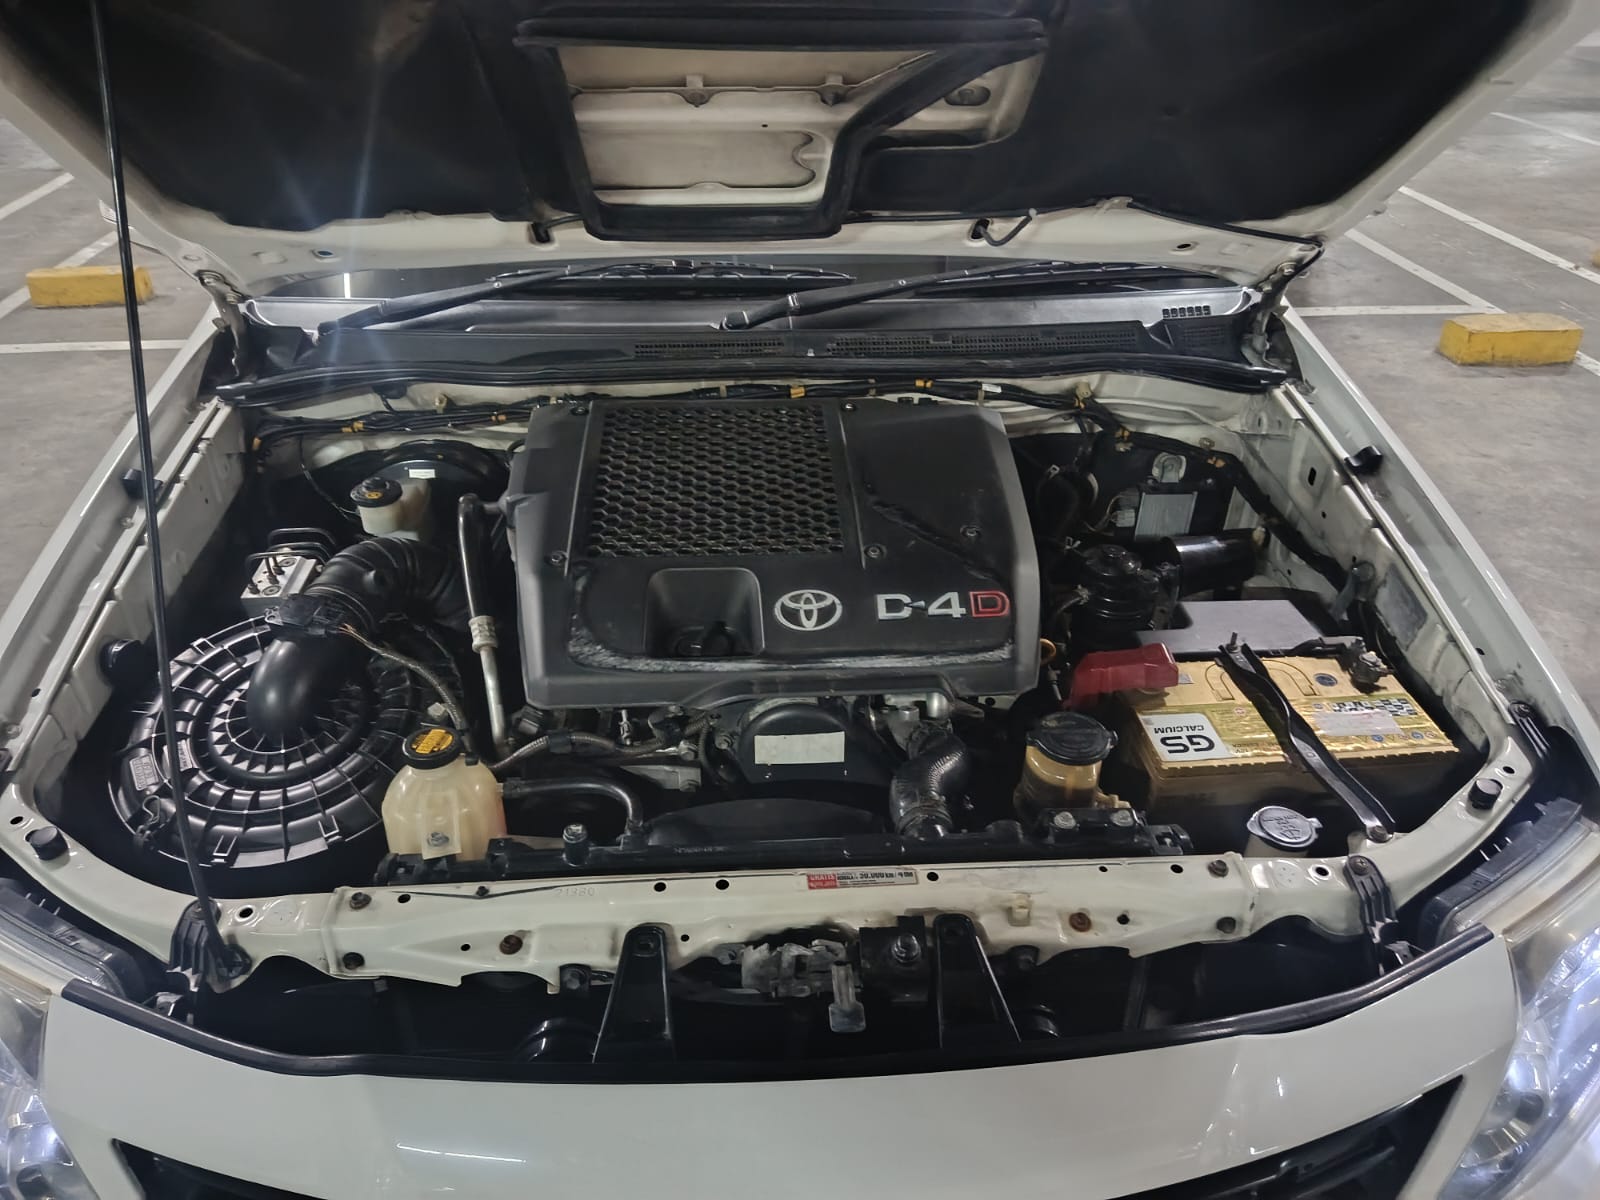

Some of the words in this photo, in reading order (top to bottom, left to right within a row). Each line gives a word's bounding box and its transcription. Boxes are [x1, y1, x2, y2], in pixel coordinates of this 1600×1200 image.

[876, 590, 1010, 620] D-4D
[1153, 724, 1205, 734] CALCIUM
[1160, 735, 1215, 754] GS
